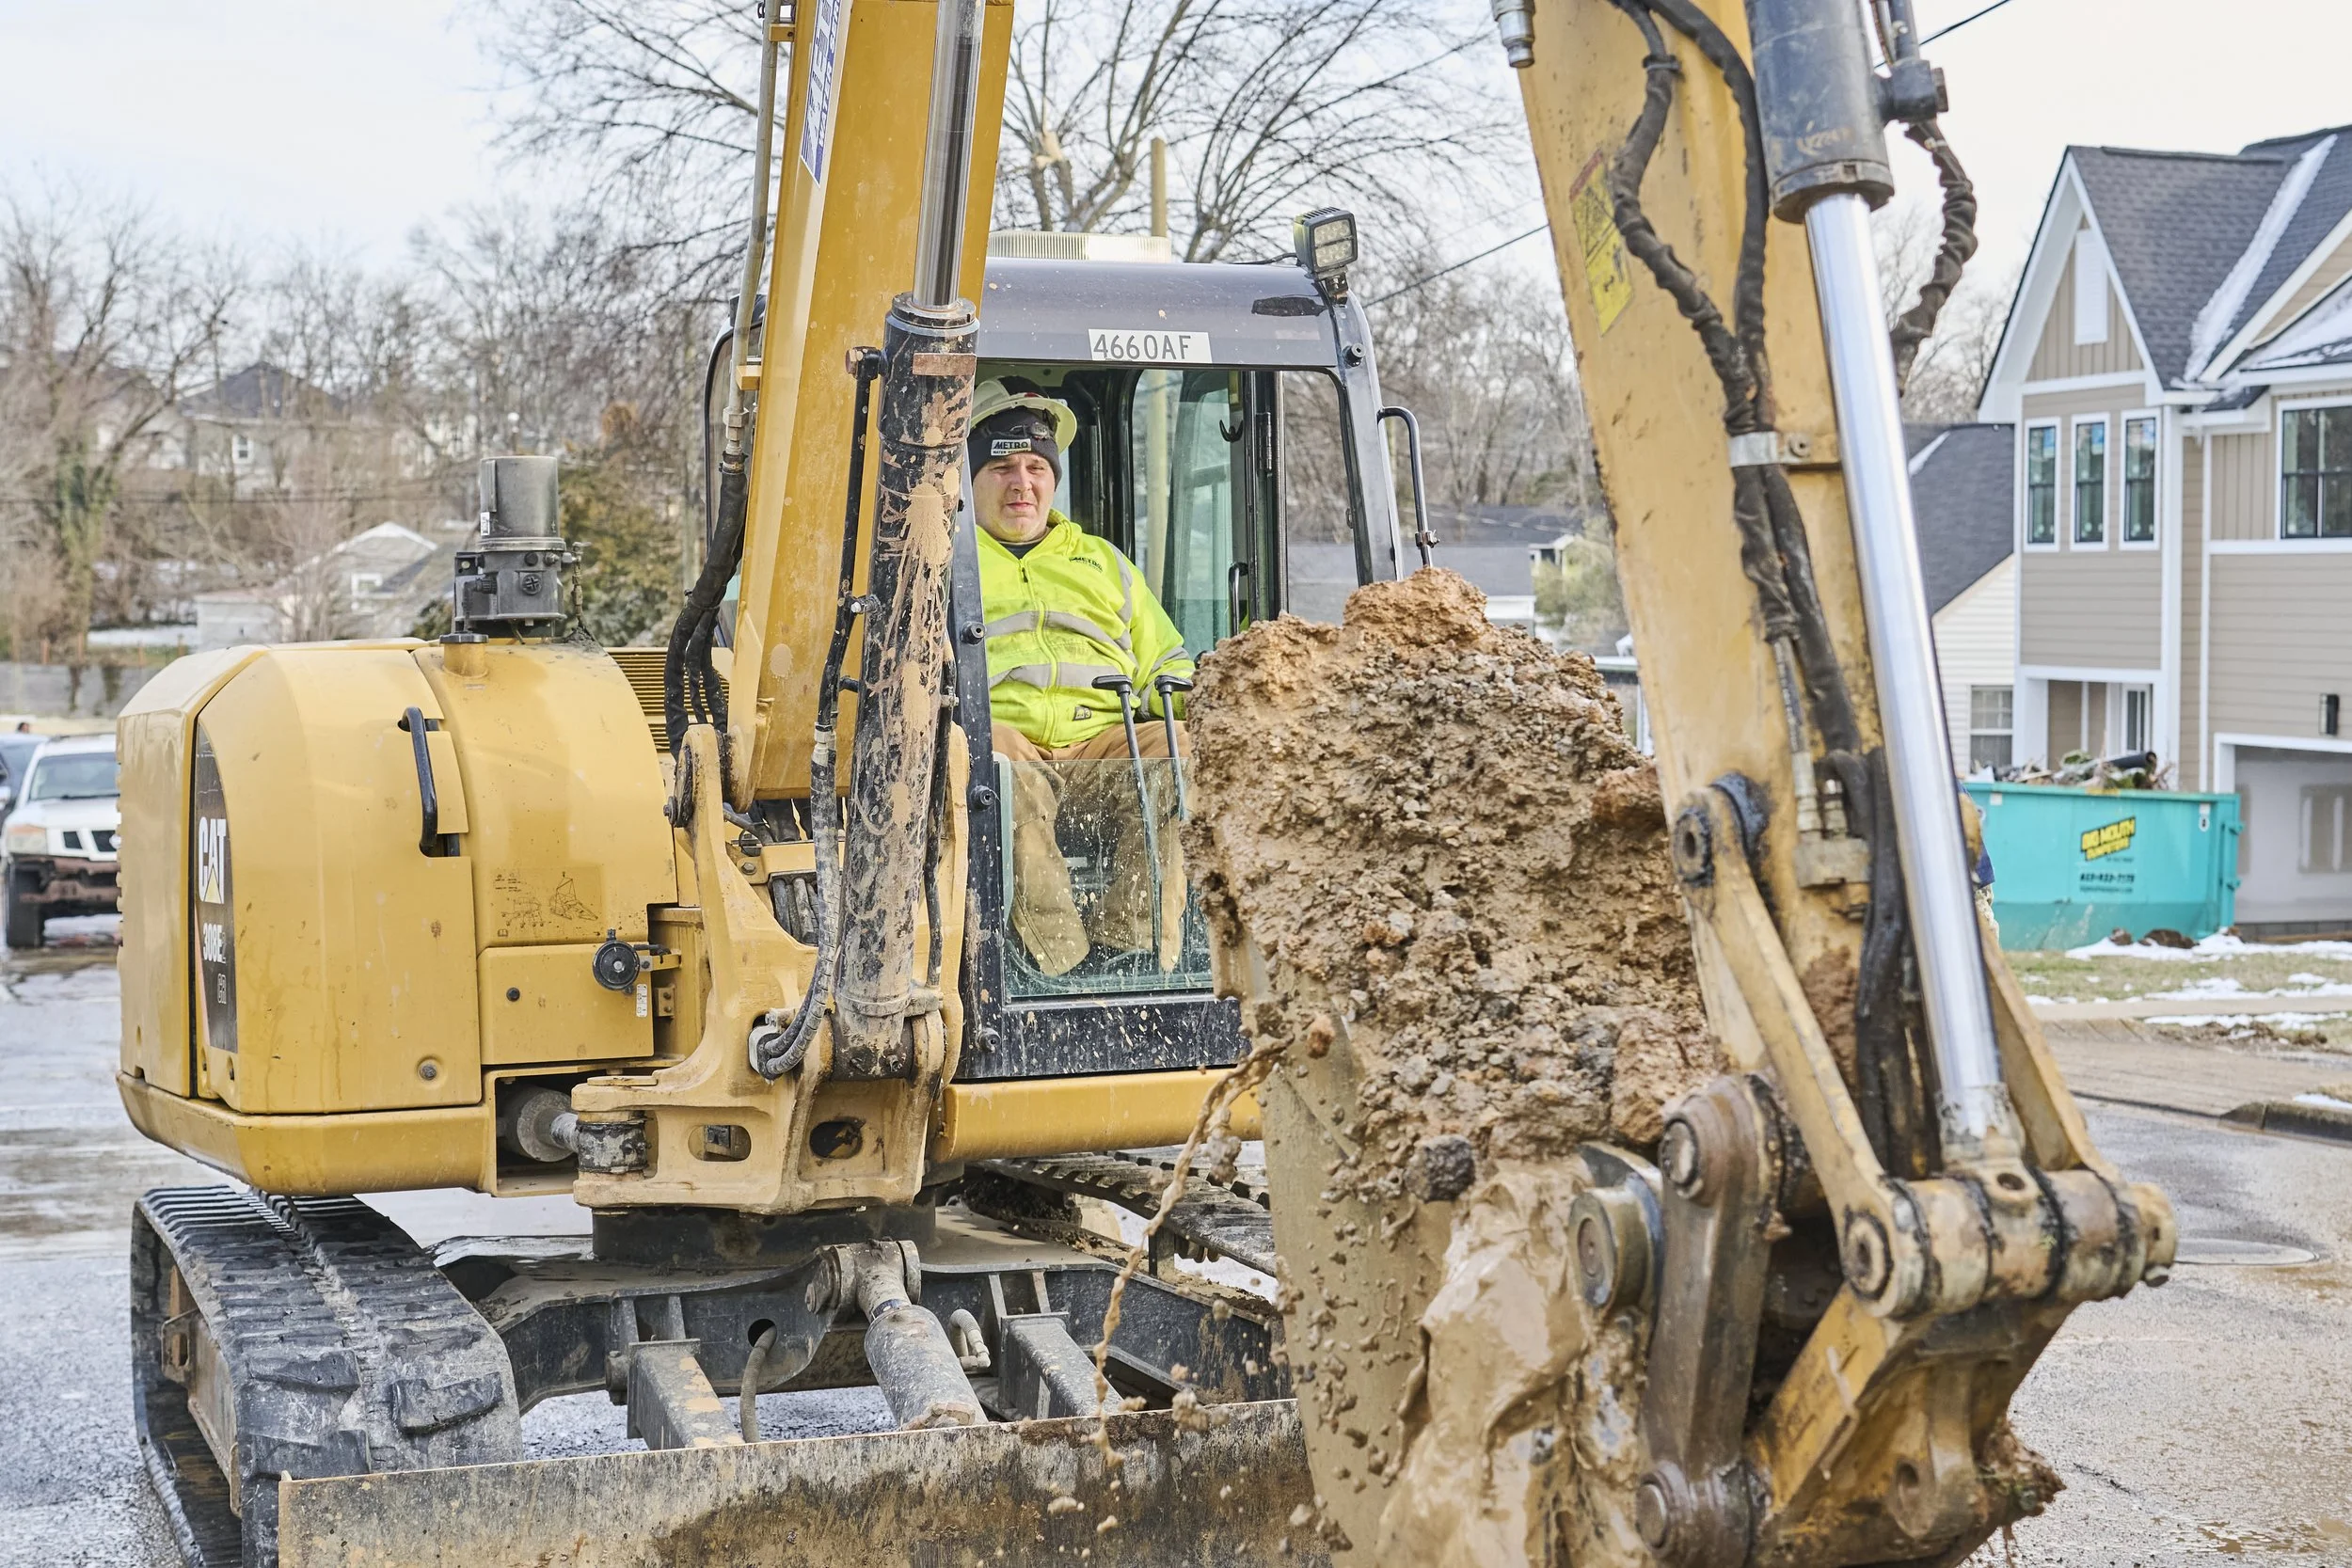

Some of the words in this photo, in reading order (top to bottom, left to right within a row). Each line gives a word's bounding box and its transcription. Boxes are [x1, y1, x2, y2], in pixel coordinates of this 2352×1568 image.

[829, 0, 841, 55] SER
[1093, 334, 1191, 359] 4660AF
[993, 441, 1028, 450] METRO
[198, 816, 227, 904] CAT
